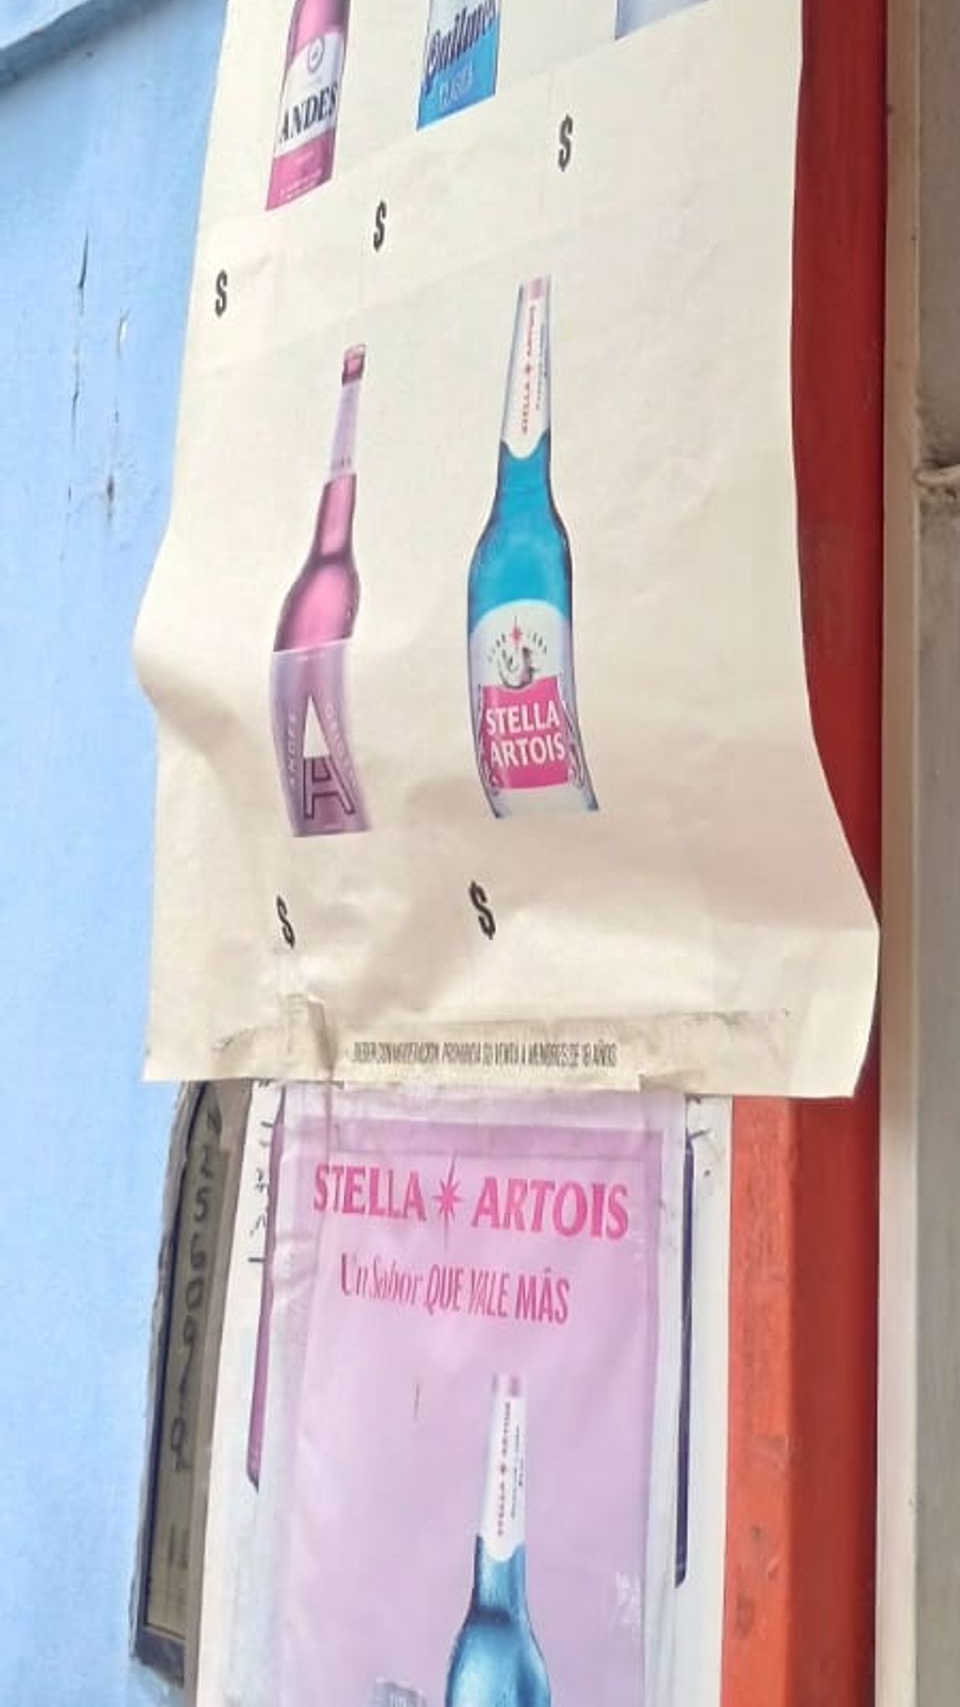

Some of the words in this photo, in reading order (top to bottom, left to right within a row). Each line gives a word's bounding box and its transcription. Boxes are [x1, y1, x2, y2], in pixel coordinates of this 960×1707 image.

[279, 82, 338, 145] ANDES
[557, 114, 573, 172] $
[373, 200, 387, 251] $
[214, 269, 228, 317] $
[485, 700, 561, 736] STELLA
[490, 732, 567, 768] ARTOIS
[276, 895, 296, 949] $
[470, 881, 496, 939] $
[313, 1162, 428, 1223] STELLA
[471, 1176, 629, 1241] ARTOIS
[341, 1251, 369, 1296] Un
[372, 1254, 424, 1307] Sabor
[424, 1263, 464, 1316] QUE
[466, 1266, 511, 1319] VALE
[514, 1267, 571, 1325] MÁS
